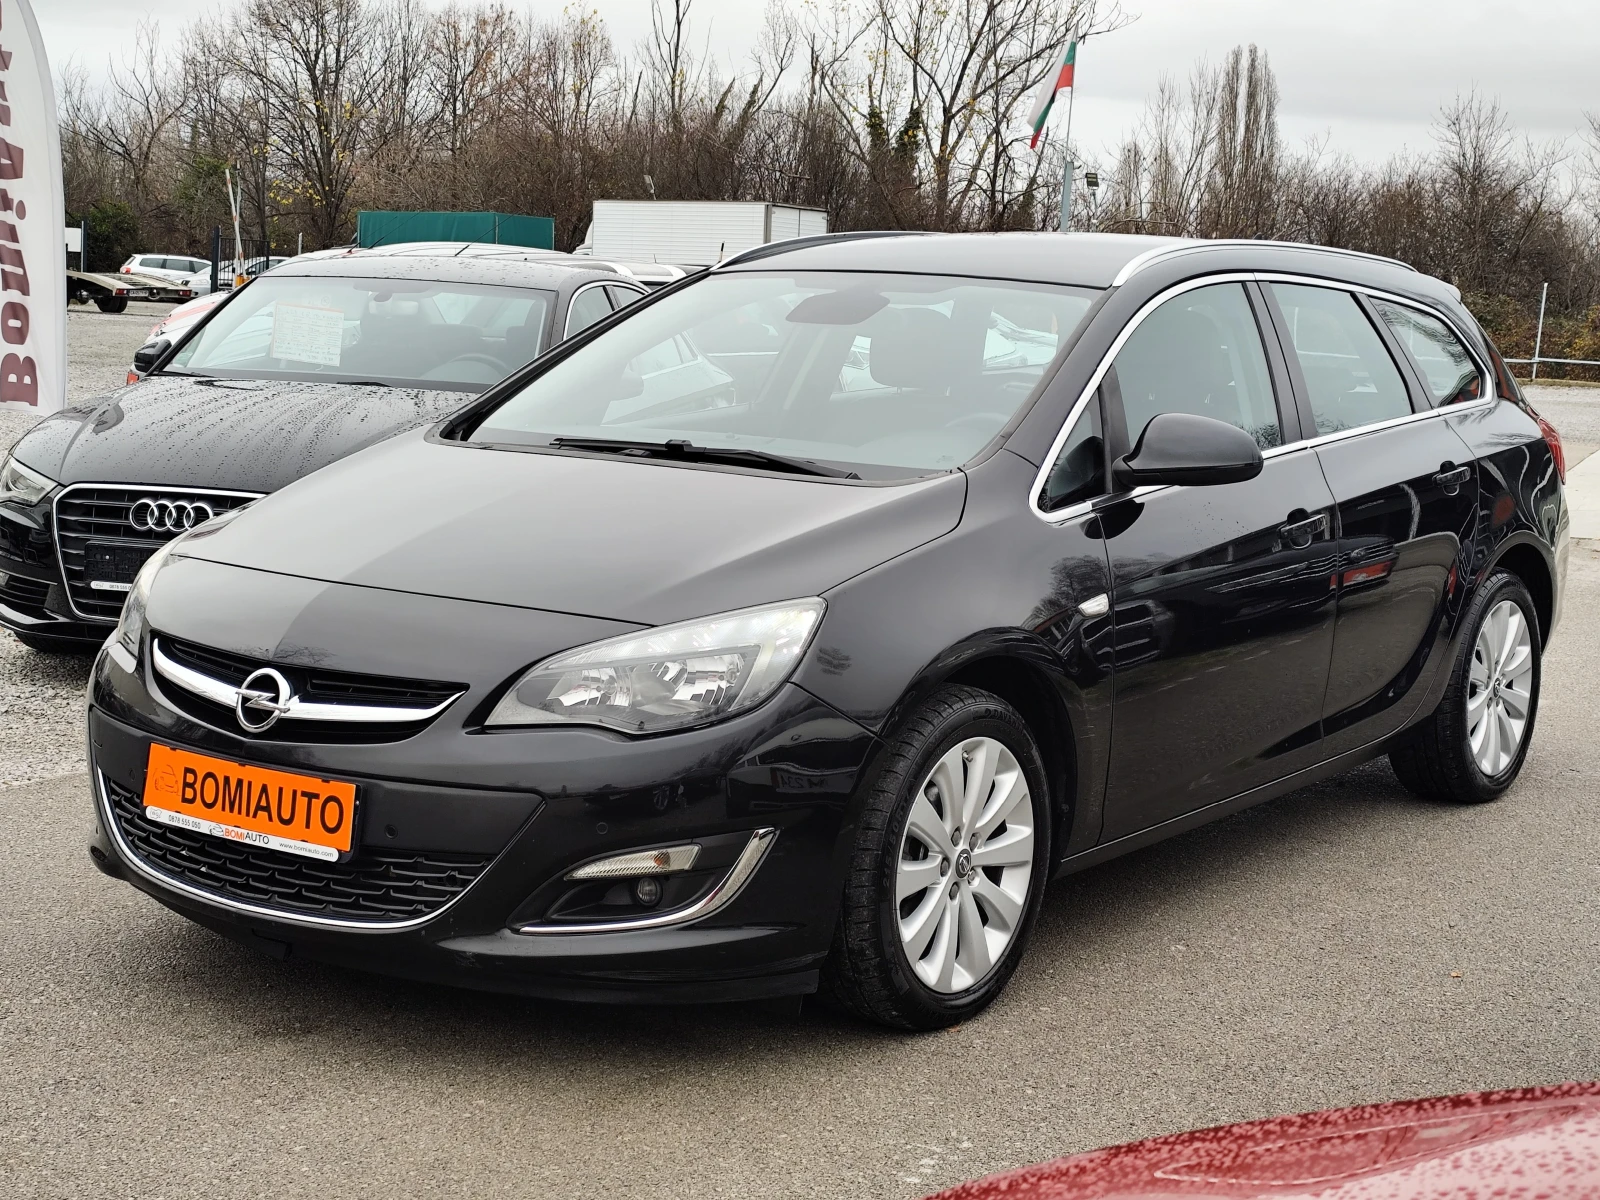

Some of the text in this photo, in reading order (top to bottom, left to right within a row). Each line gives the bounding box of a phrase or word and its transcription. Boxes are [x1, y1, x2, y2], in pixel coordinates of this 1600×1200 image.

[181, 766, 344, 835] BOMIAUTO
[168, 814, 202, 829] 0878 555 050
[224, 826, 270, 845] BOMIAUTO
[278, 841, 334, 858] www.bomiauto.com
